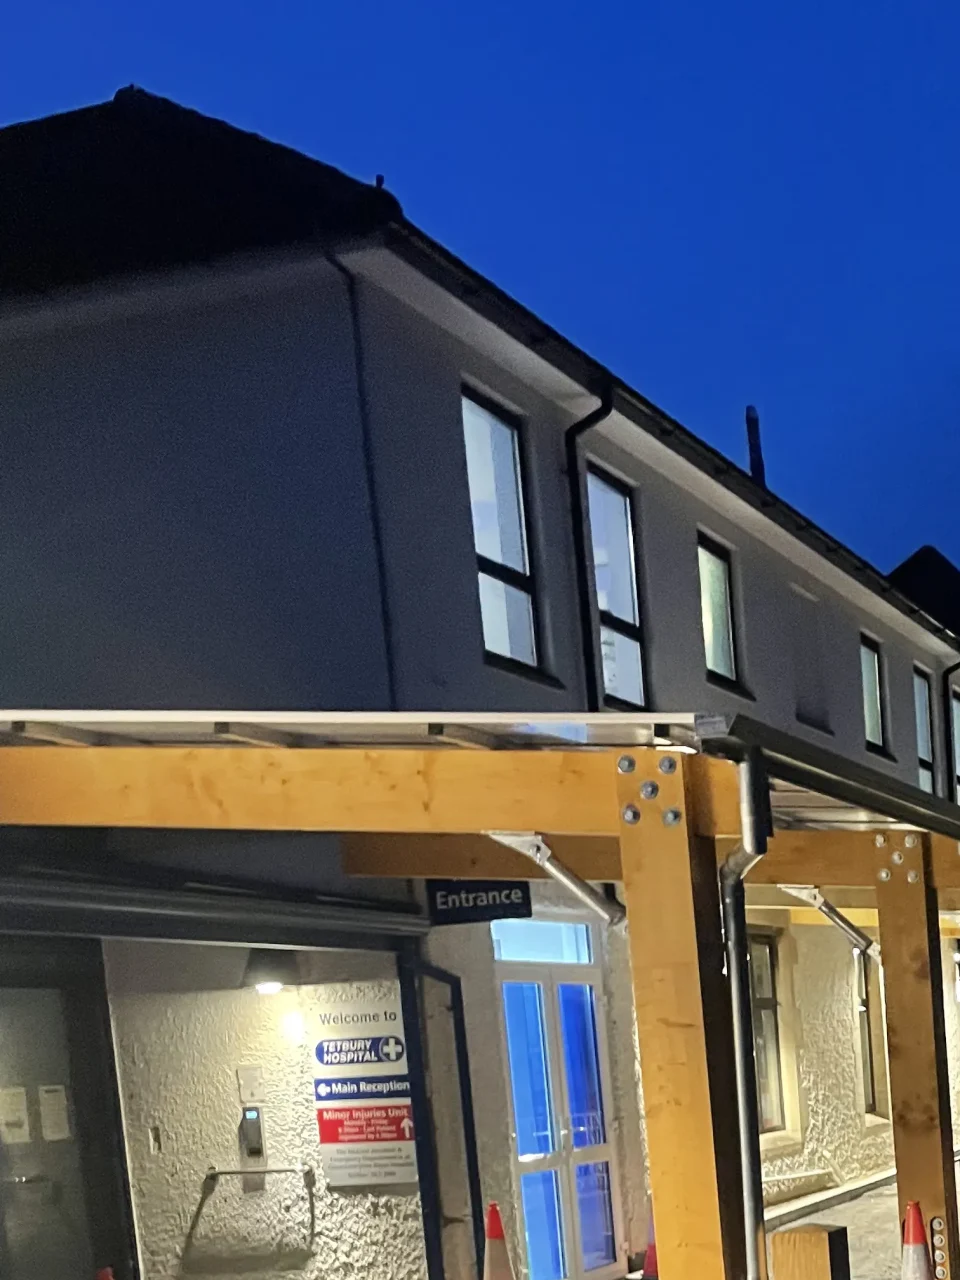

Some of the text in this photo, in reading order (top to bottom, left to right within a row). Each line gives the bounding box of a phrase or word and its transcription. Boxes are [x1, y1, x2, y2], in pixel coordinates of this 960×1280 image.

[435, 888, 523, 909] Entrance
[319, 1010, 397, 1026] Welcome to
[322, 1039, 373, 1053] TETBURY
[323, 1050, 378, 1064] HOSPITAL
[331, 1080, 410, 1094] Main Reception
[323, 1107, 409, 1120] Minor Injuries Unit
